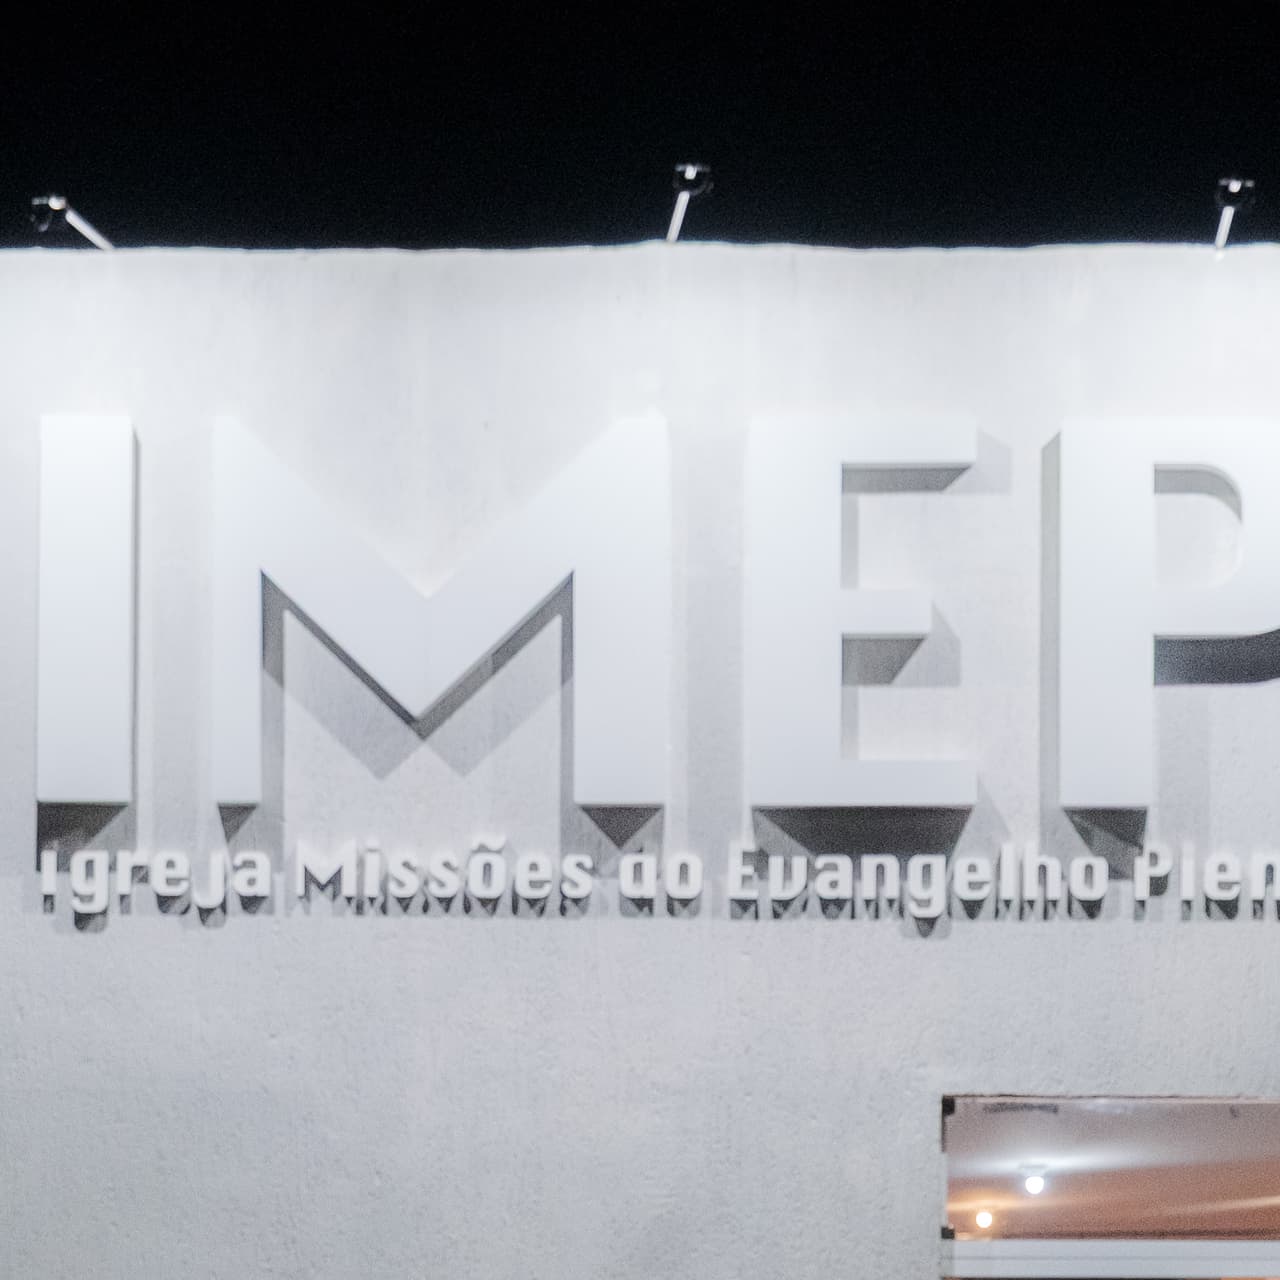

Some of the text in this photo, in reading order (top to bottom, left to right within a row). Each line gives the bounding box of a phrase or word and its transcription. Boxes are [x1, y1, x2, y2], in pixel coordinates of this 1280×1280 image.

[39, 841, 272, 914] Igreja
[295, 839, 595, 900] Missões
[619, 841, 704, 900] do
[727, 840, 1111, 918] Evangelho
